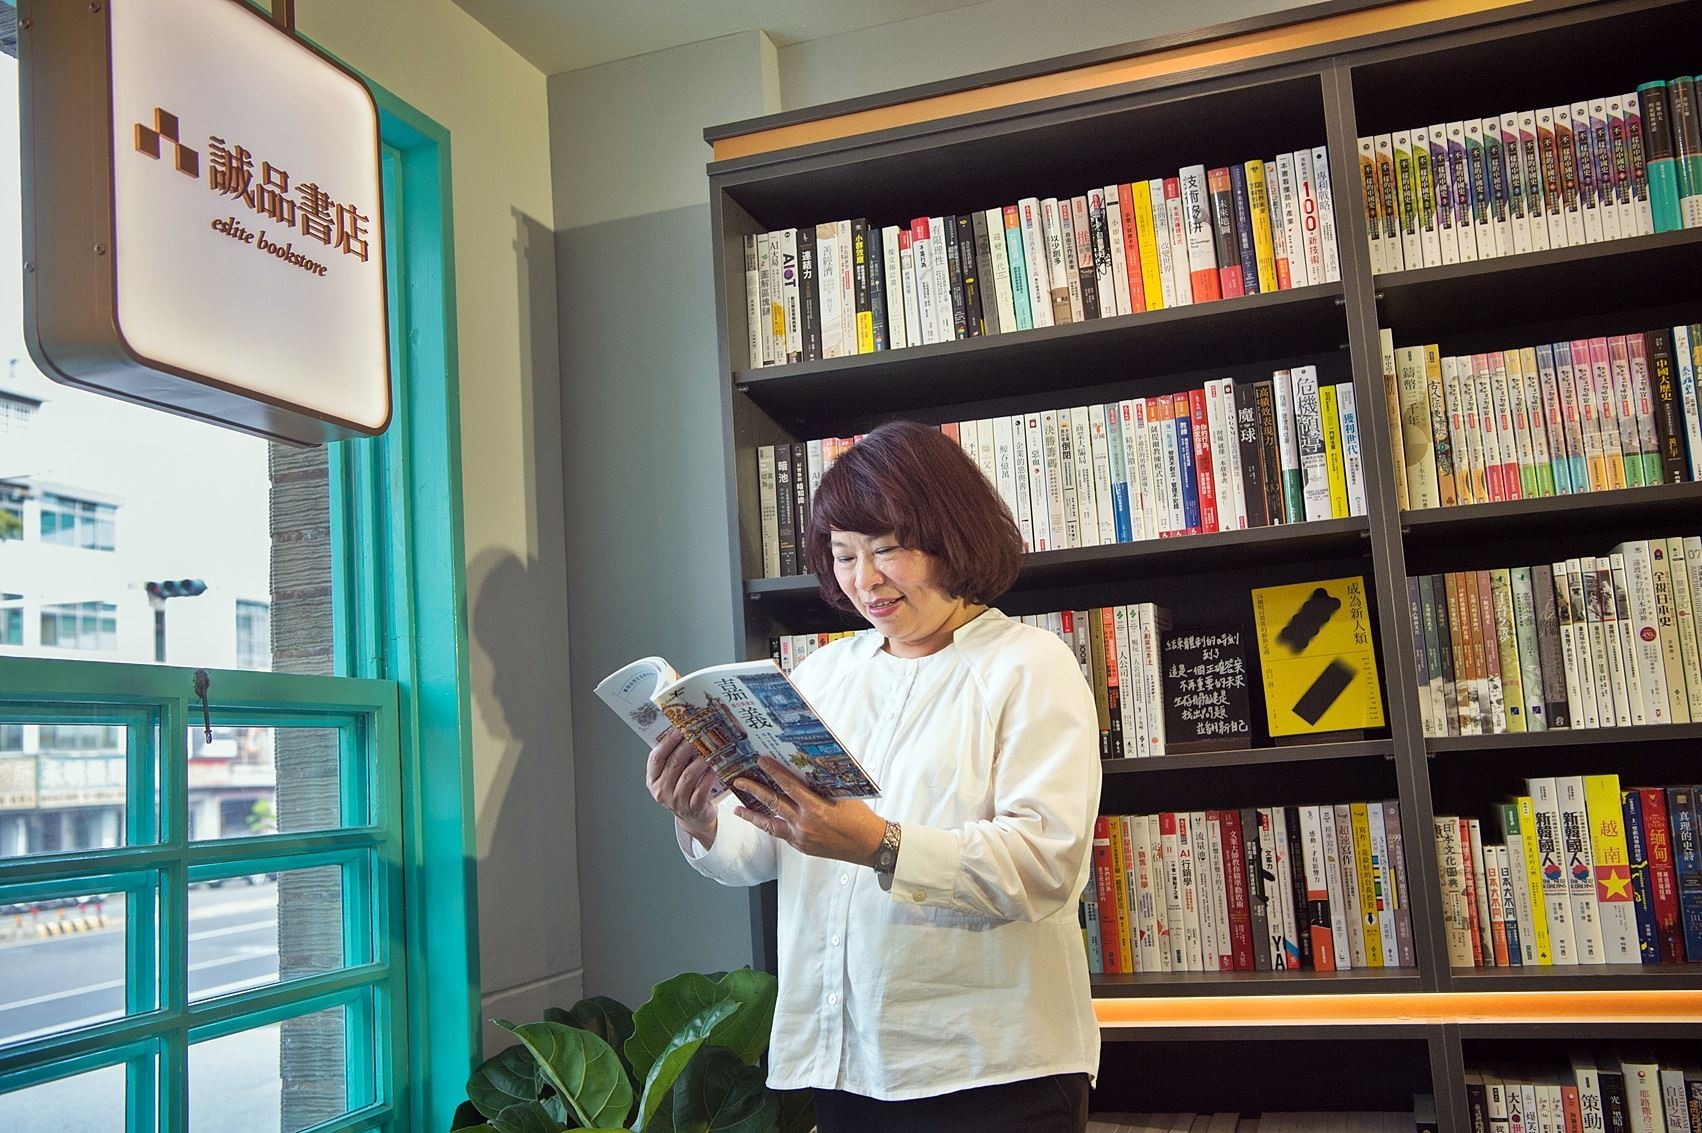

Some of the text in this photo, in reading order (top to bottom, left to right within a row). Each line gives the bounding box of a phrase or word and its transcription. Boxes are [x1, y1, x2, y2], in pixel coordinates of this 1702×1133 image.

[208, 135, 369, 262] 誠品書店
[211, 216, 328, 277] eslite bookstore
[783, 253, 797, 287] AIOT
[802, 250, 812, 280] 連結力
[1656, 359, 1673, 402] 中國大歷史
[1239, 408, 1257, 445] 魔球
[1296, 378, 1322, 453] 危機領導
[1061, 442, 1073, 461] 倒閉
[1344, 413, 1359, 456] 獲利世代
[778, 461, 790, 484] 暗池
[1347, 582, 1369, 646] 成為新人類
[1118, 644, 1129, 678] 一人公司
[1168, 657, 1245, 678] 這是一個正確答案
[1202, 648, 1220, 661] 到了
[1179, 675, 1245, 693] 不再重要的未來
[1181, 705, 1229, 721] 找出問題
[1196, 720, 1249, 736] 並翻新自己
[1195, 831, 1206, 861] 流量池
[1536, 811, 1555, 867] 新韓國人
[1562, 811, 1582, 867] 新韓國人
[1600, 820, 1621, 865] 越南
[1679, 811, 1695, 862] 真理的史詩
[1264, 850, 1274, 870] 文案力
[1443, 823, 1460, 889] 日本文化圖典
[1526, 1111, 1537, 1133] 爆笑
[1581, 1094, 1602, 1130] 策動
[1639, 1089, 1653, 1133] 耶路撒冷三
[1666, 1085, 1683, 1129] 自由之城
